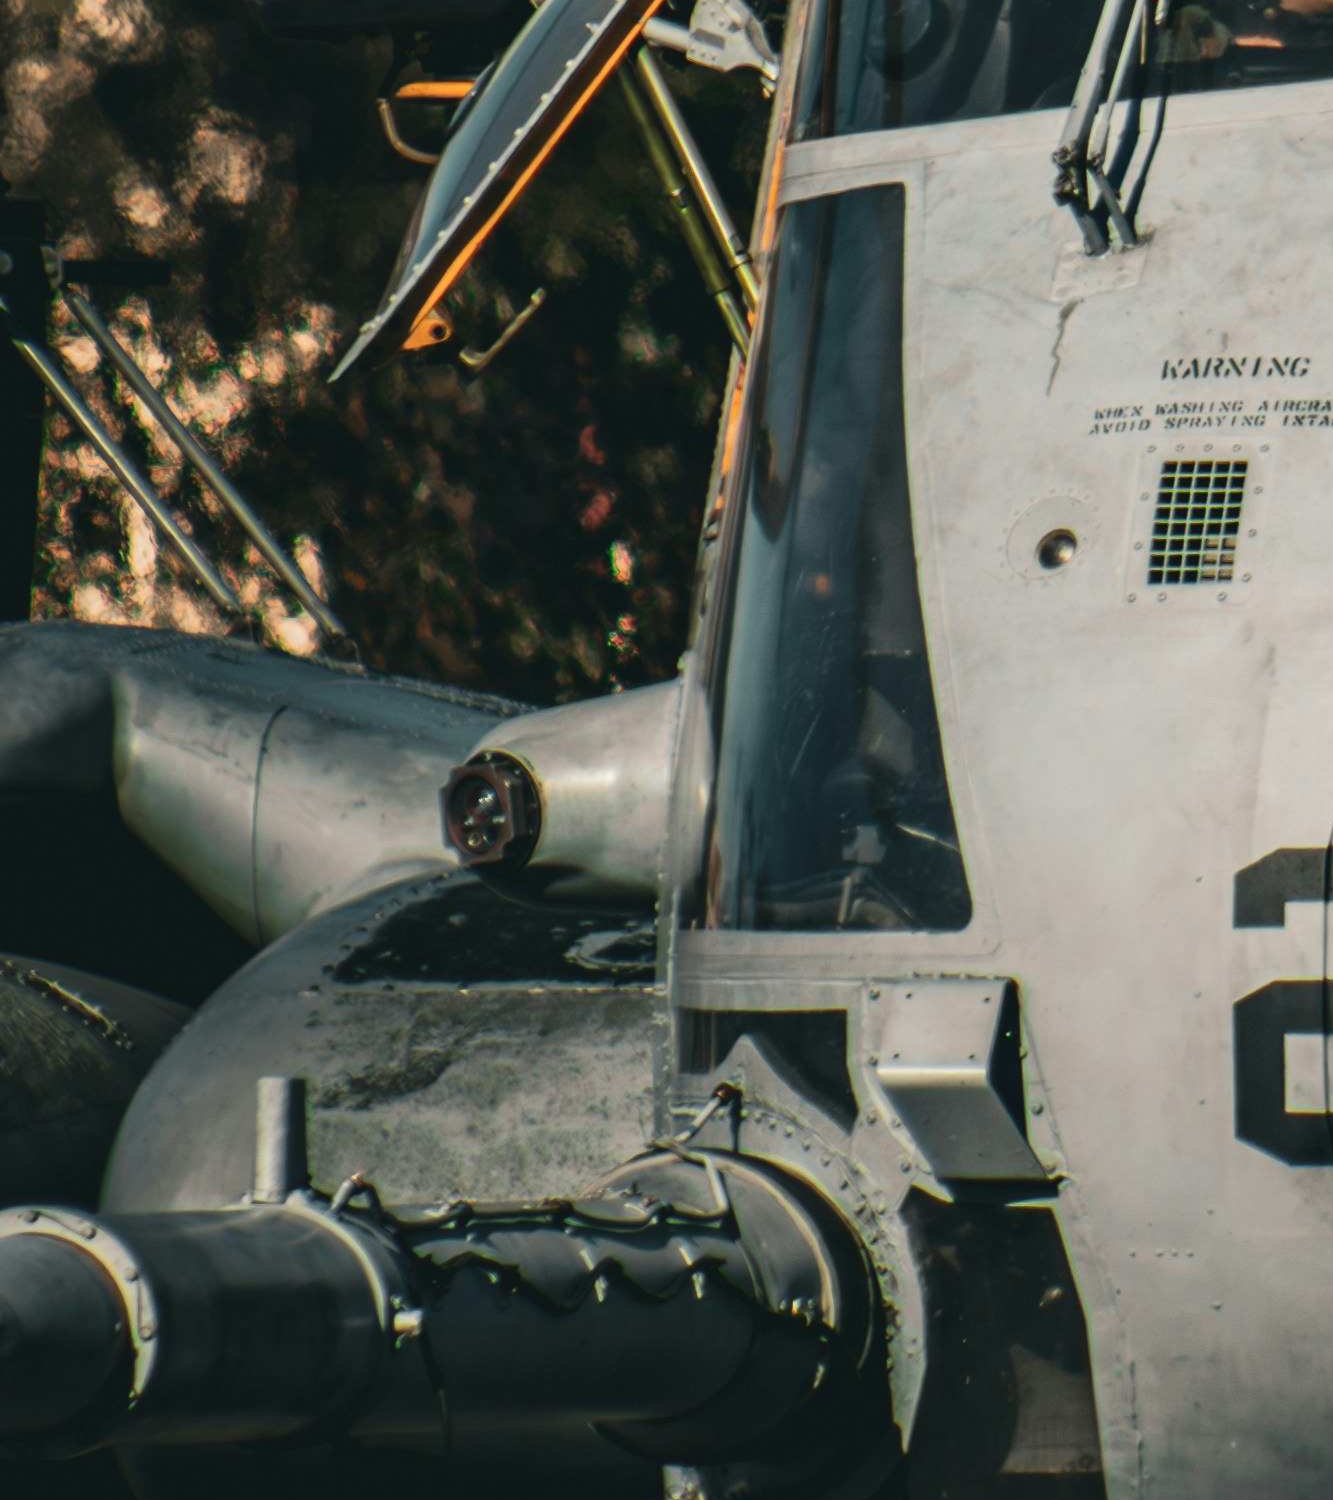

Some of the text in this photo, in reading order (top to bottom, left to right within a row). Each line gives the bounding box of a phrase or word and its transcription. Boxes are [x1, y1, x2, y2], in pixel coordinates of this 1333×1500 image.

[1161, 355, 1312, 380] WARNING
[1093, 404, 1144, 421] WHEN
[1155, 399, 1245, 416] WASHING
[1088, 418, 1152, 436] AVOID
[1164, 414, 1267, 430] SPRAYING
